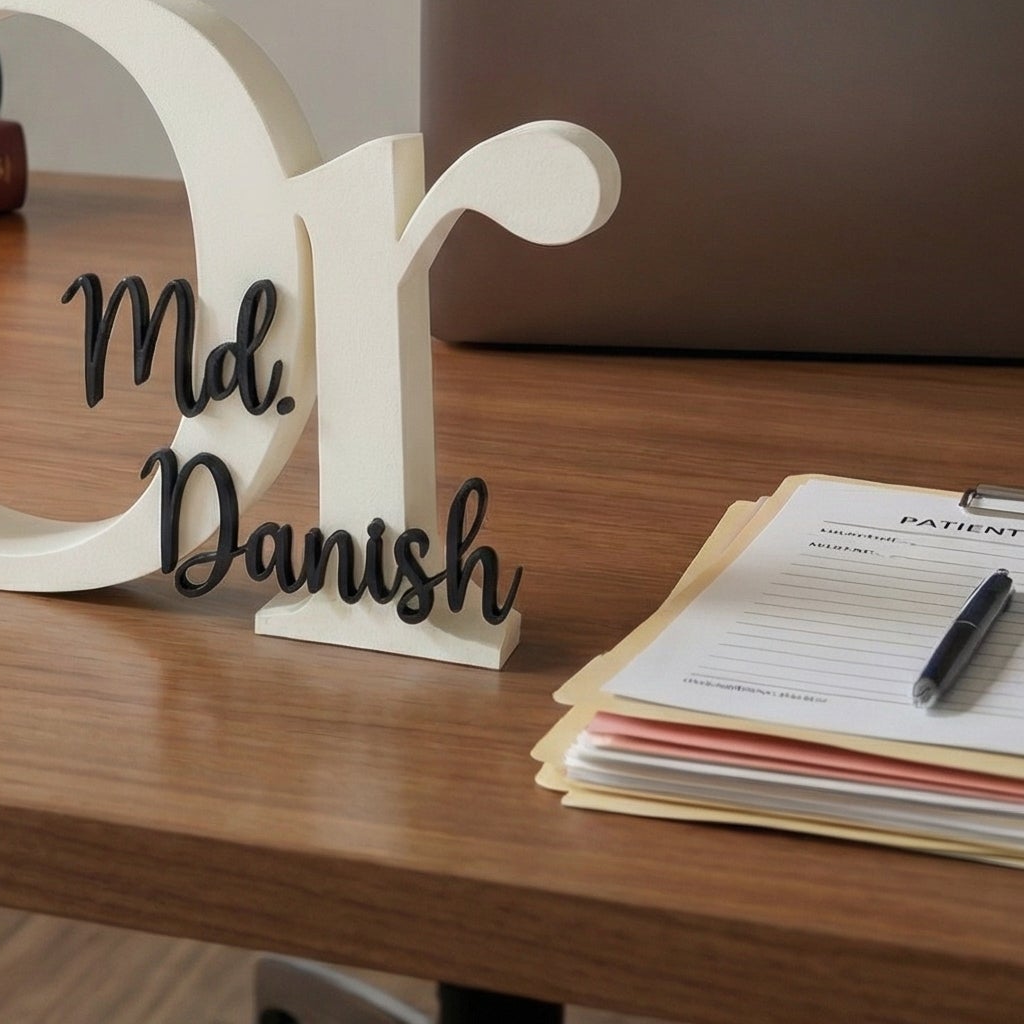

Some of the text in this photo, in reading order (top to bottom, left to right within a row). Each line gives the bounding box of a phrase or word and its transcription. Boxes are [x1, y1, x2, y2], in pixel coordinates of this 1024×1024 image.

[61, 273, 296, 418] Md.
[141, 447, 524, 626] Danish
[899, 516, 1024, 537] PATIENT
